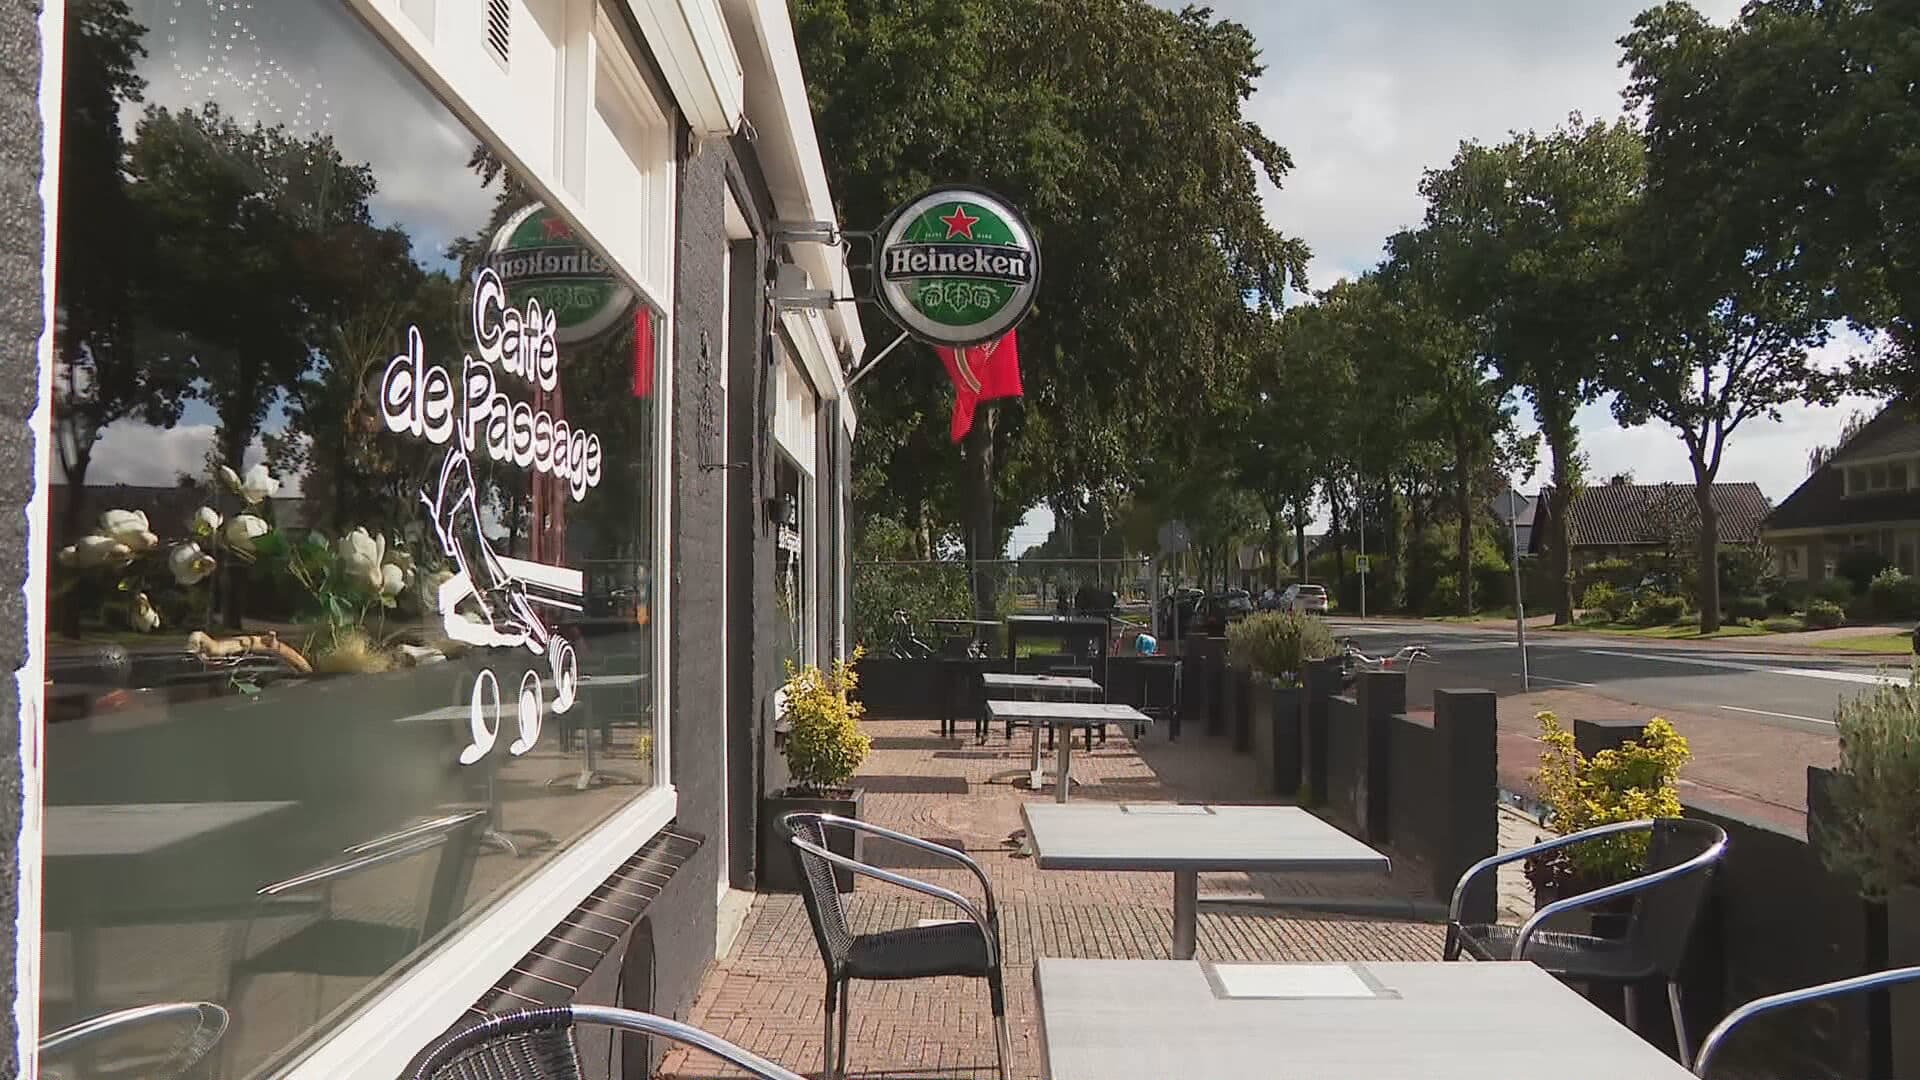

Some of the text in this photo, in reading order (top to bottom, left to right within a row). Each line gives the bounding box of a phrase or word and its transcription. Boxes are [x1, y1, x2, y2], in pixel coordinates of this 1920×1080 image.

[891, 247, 1026, 277] Heineken
[472, 266, 559, 392] Café
[380, 324, 602, 502] de Passage
